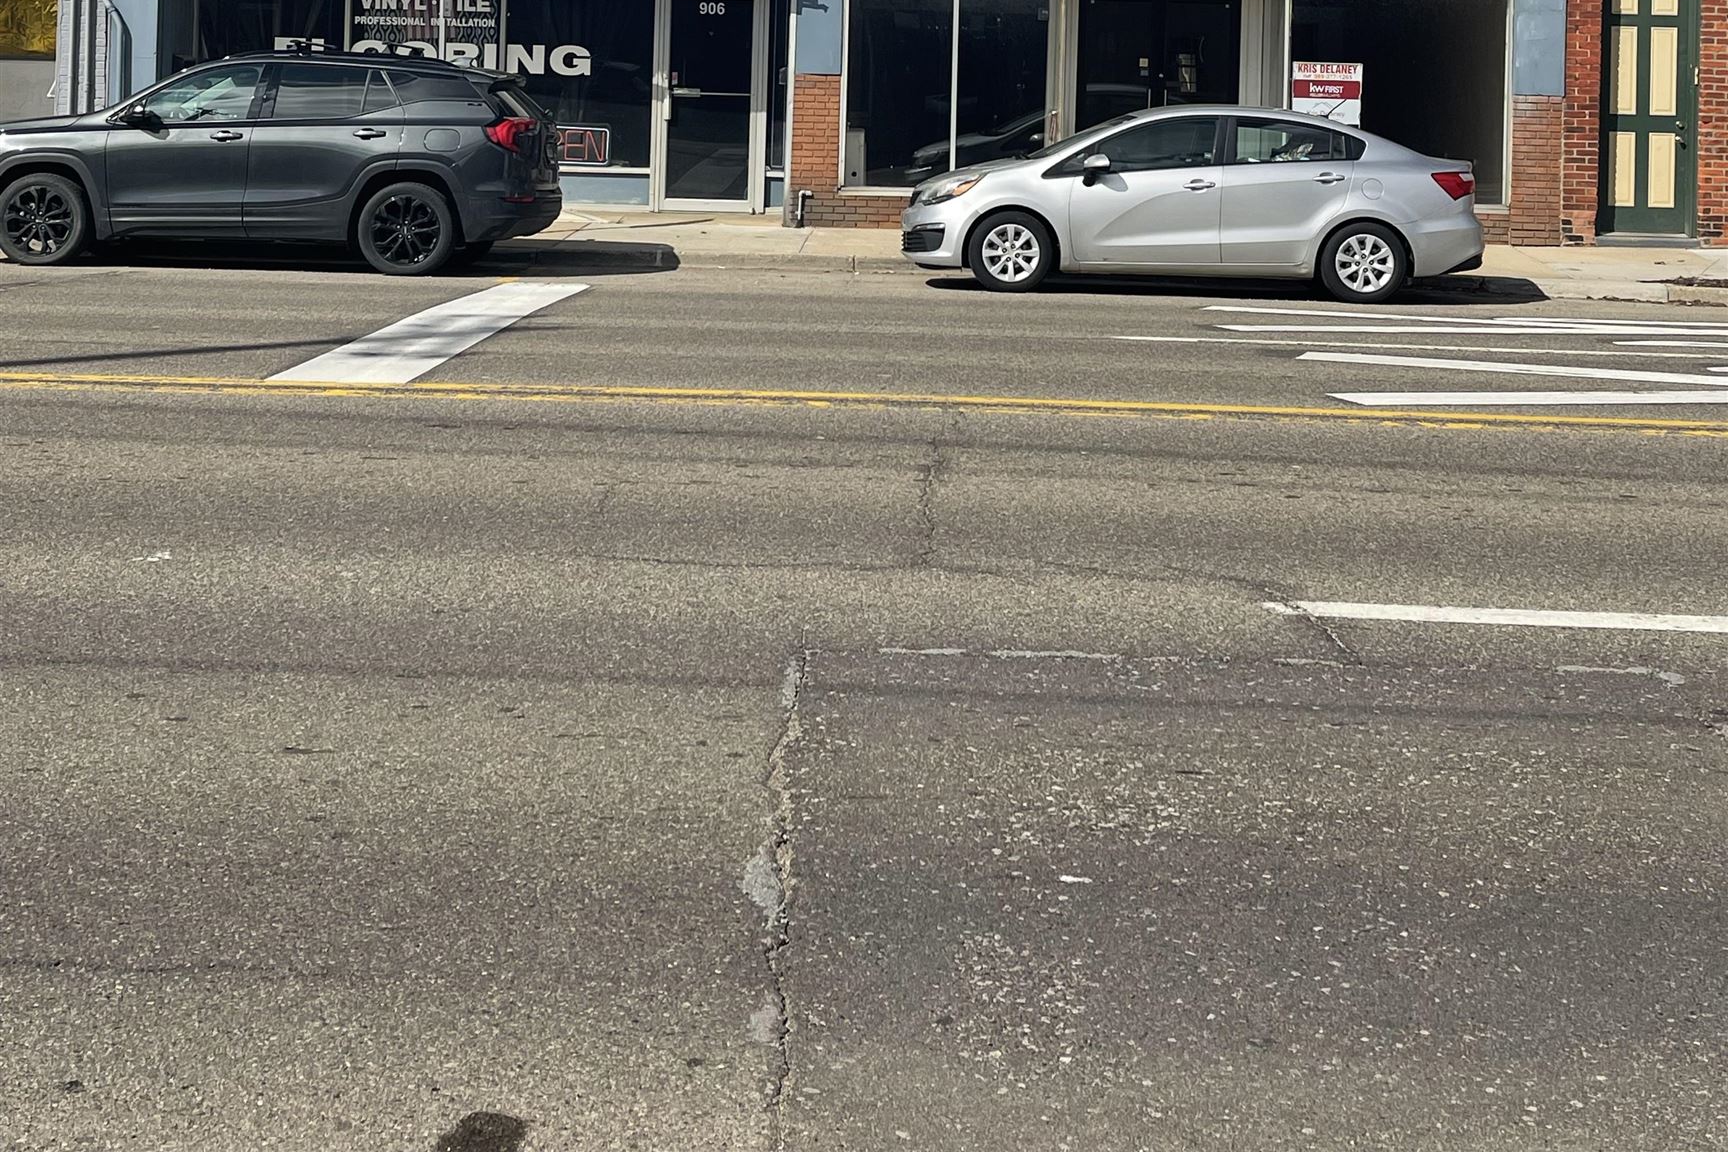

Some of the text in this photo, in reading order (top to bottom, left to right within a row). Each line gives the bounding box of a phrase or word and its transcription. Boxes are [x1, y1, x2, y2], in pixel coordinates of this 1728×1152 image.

[699, 2, 726, 15] 906
[354, 15, 496, 28] PROFESSIONAL INTALLATION
[1297, 63, 1359, 75] KRIS DELANEY
